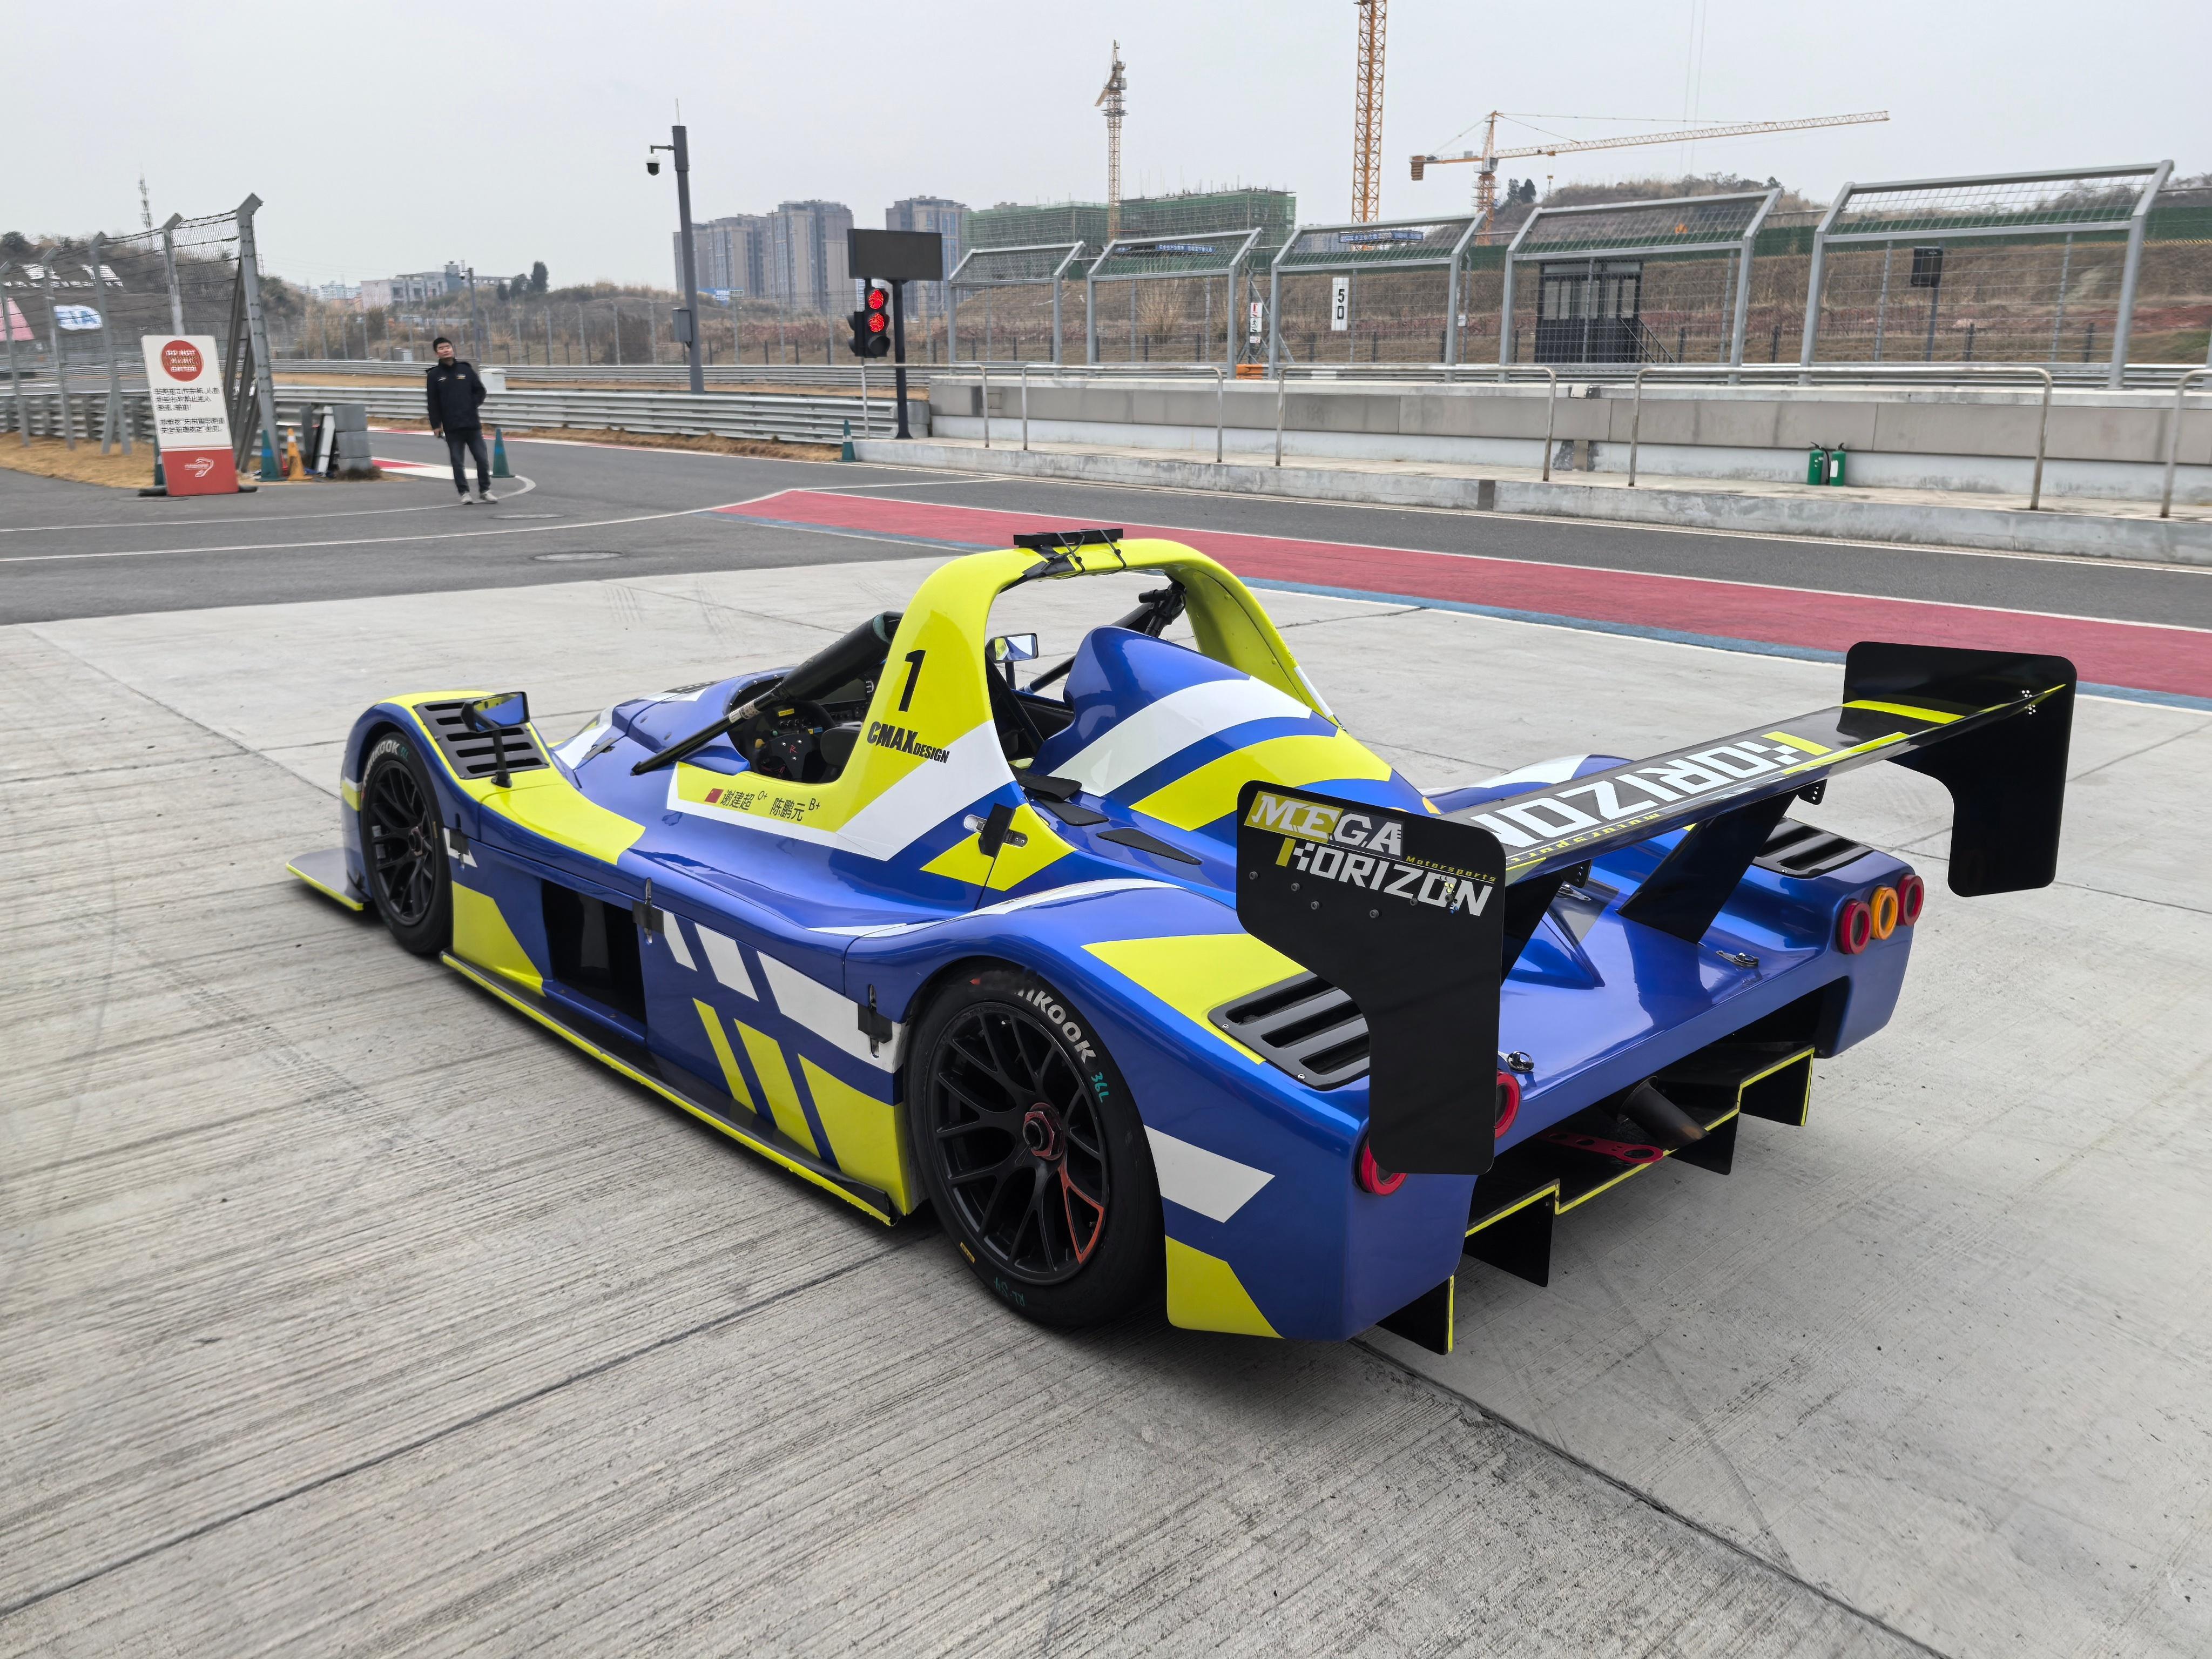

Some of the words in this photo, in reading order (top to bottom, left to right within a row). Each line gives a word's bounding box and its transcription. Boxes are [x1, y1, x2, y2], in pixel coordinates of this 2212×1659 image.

[1337, 288, 1345, 320] 50
[899, 650, 926, 712] 1
[913, 743, 950, 764] DESIGN
[770, 797, 806, 822] 陈鹏元
[808, 798, 820, 811] B+
[1251, 795, 1402, 857] MEGA
[1405, 855, 1498, 883] Motorsports
